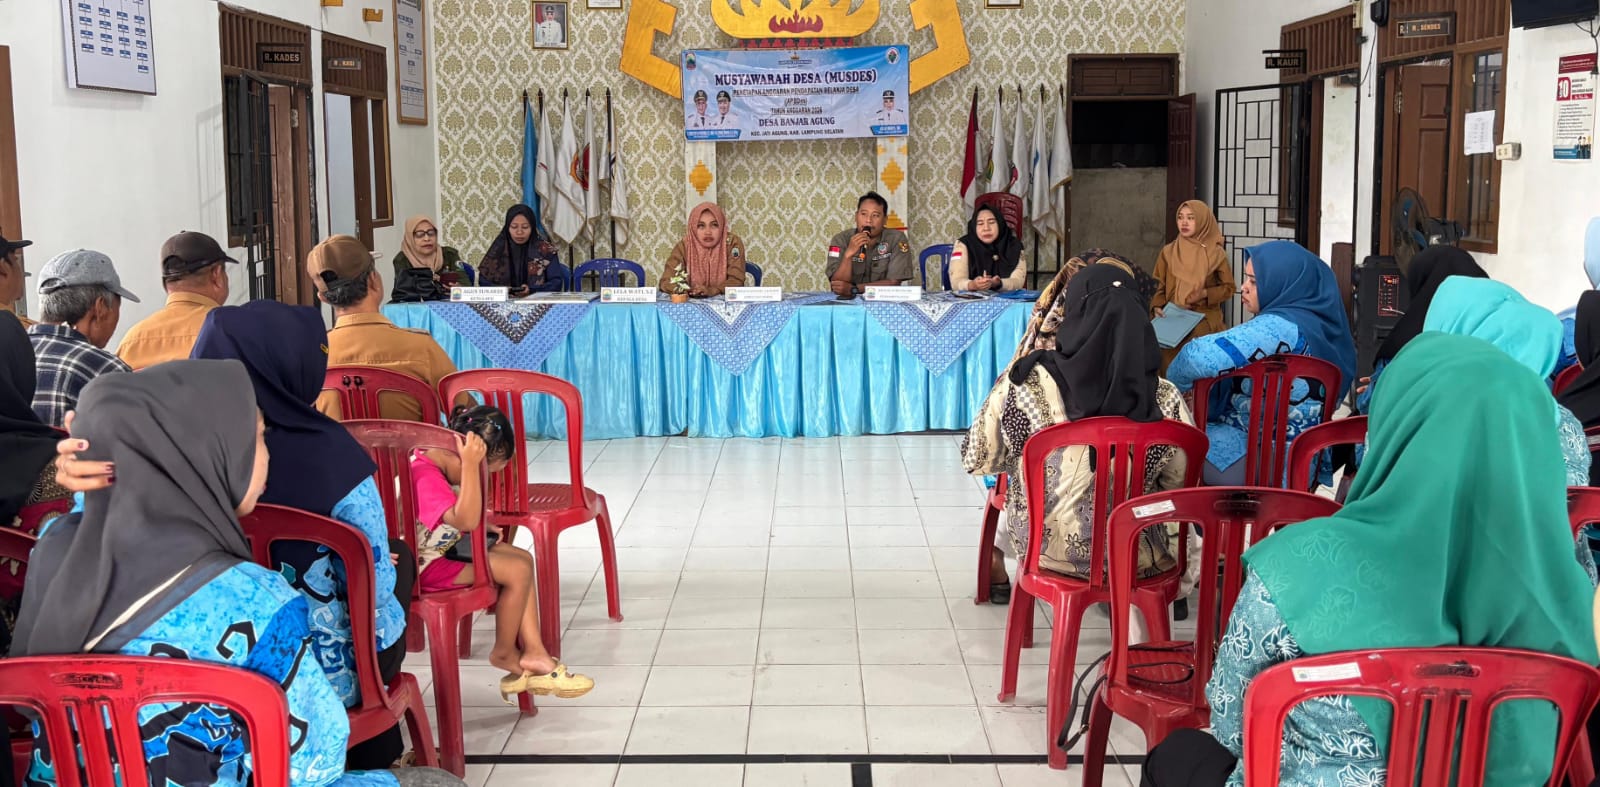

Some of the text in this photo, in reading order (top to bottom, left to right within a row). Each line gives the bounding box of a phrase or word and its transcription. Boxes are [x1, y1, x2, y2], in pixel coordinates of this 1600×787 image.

[274, 53, 300, 62] KADES
[1277, 59, 1299, 67] KAUR
[715, 69, 877, 86] MUSYAWARAH DESA (MUSDES)
[762, 88, 790, 96] ANGGARAN
[759, 117, 835, 127] DESA BANJAR AGUNG
